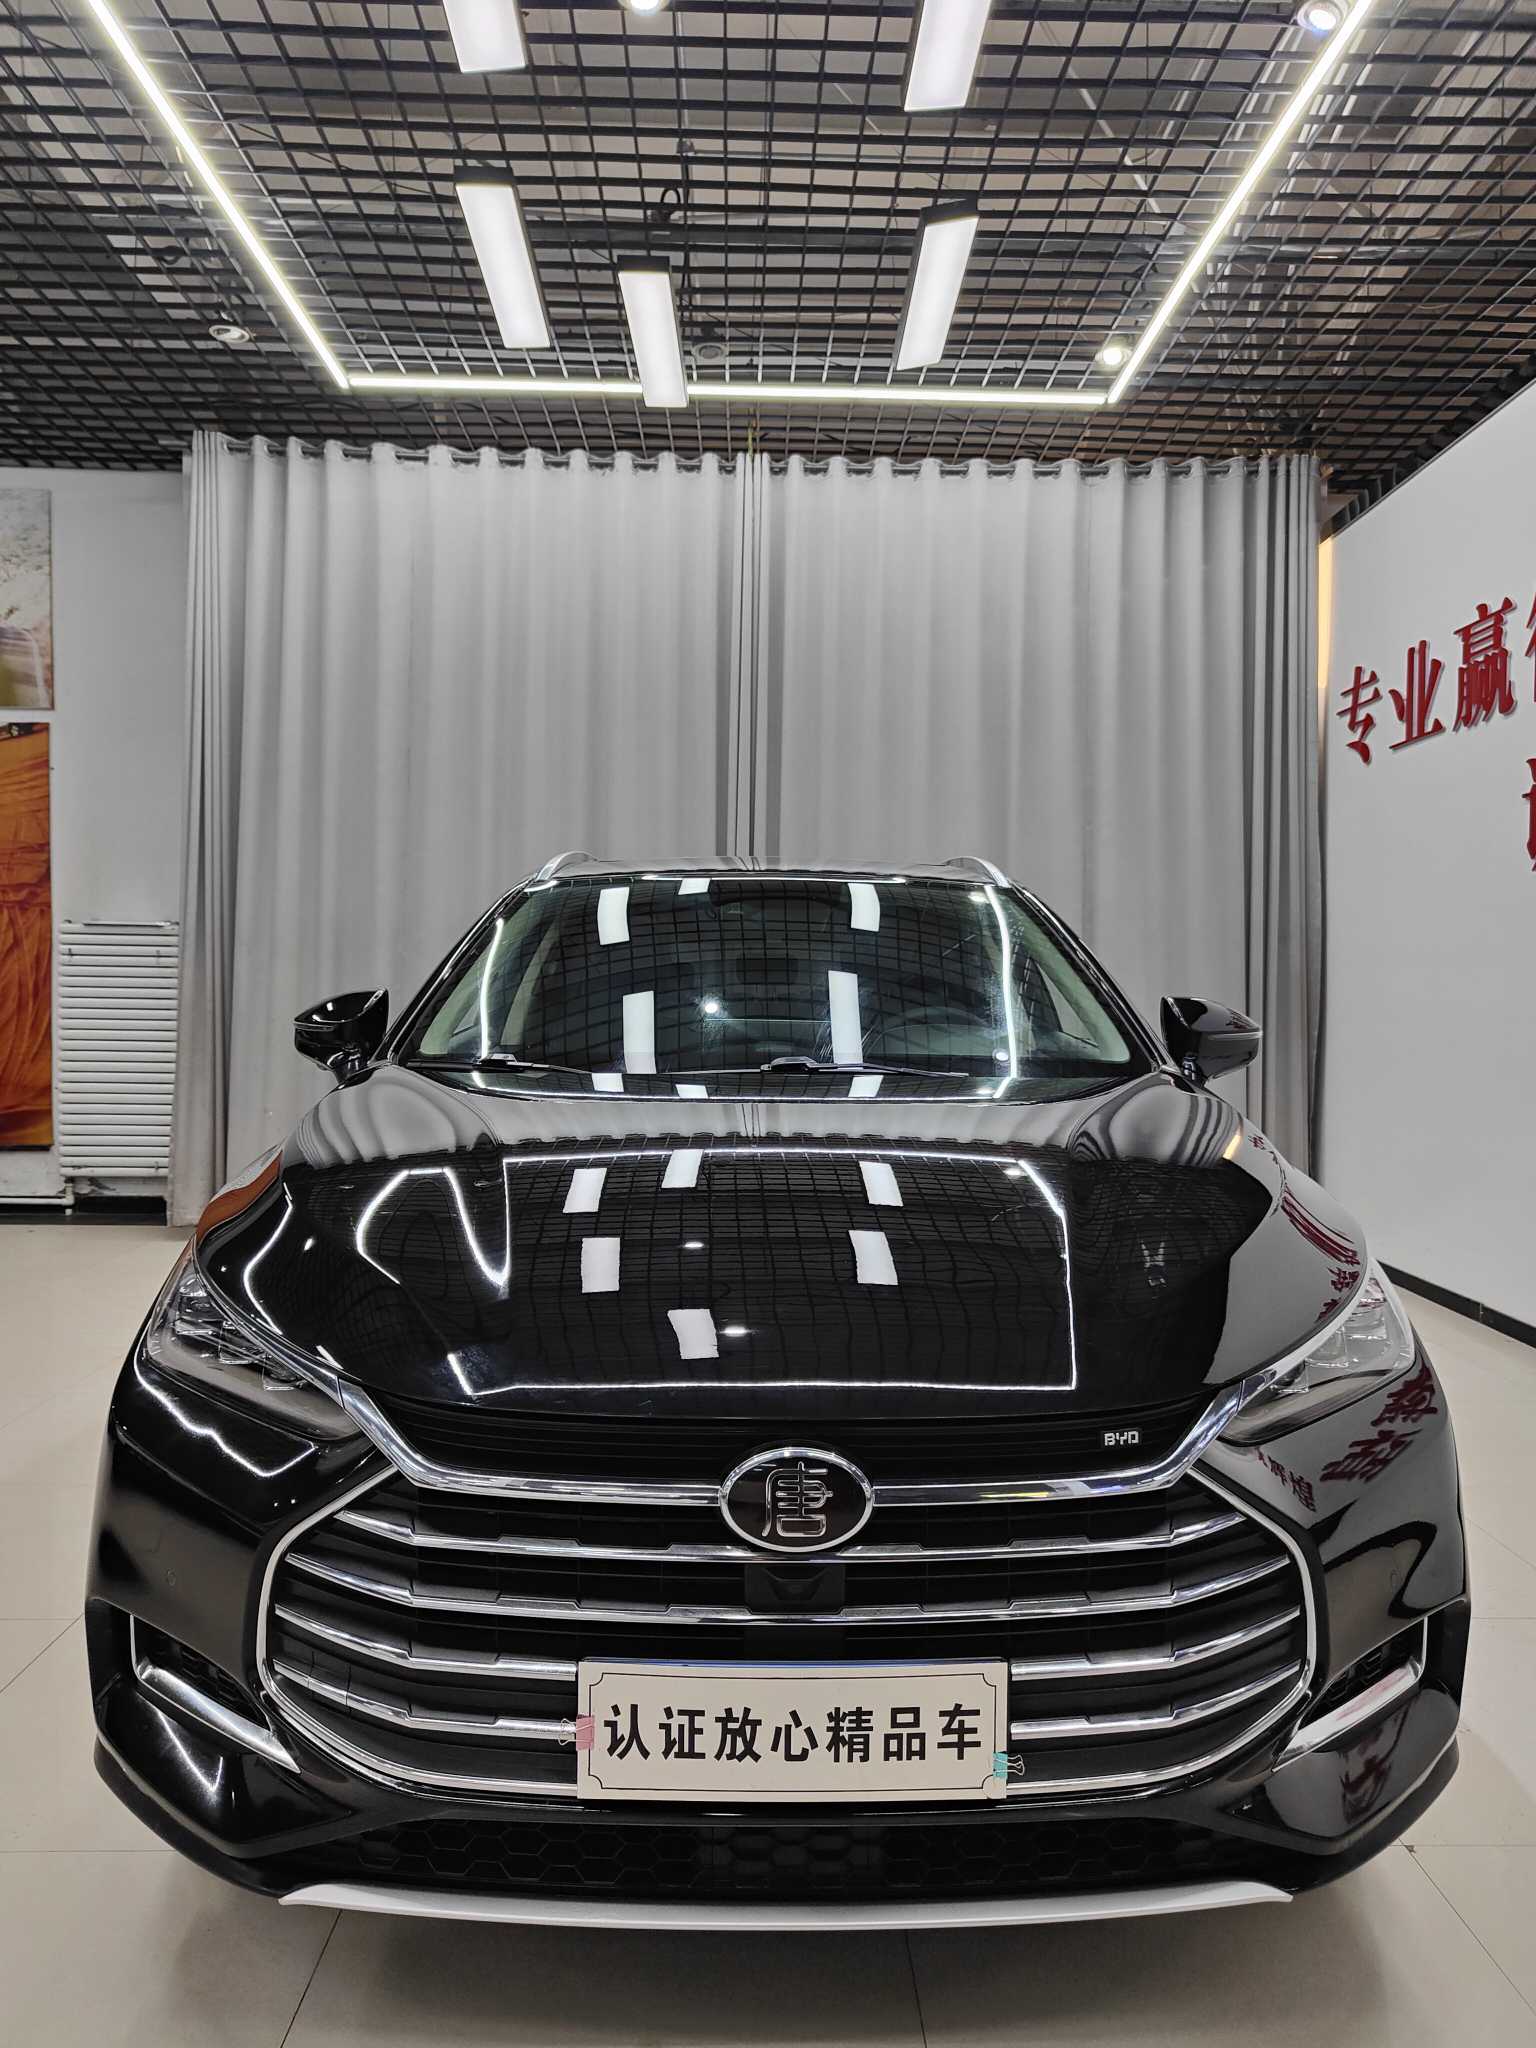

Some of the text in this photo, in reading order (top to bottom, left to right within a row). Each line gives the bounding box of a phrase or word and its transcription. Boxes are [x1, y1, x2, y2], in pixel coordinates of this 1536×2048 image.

[1336, 588, 1536, 766] 专业赢
[1104, 1431, 1139, 1446] BYD
[603, 1702, 983, 1764] 认证放心精品车
